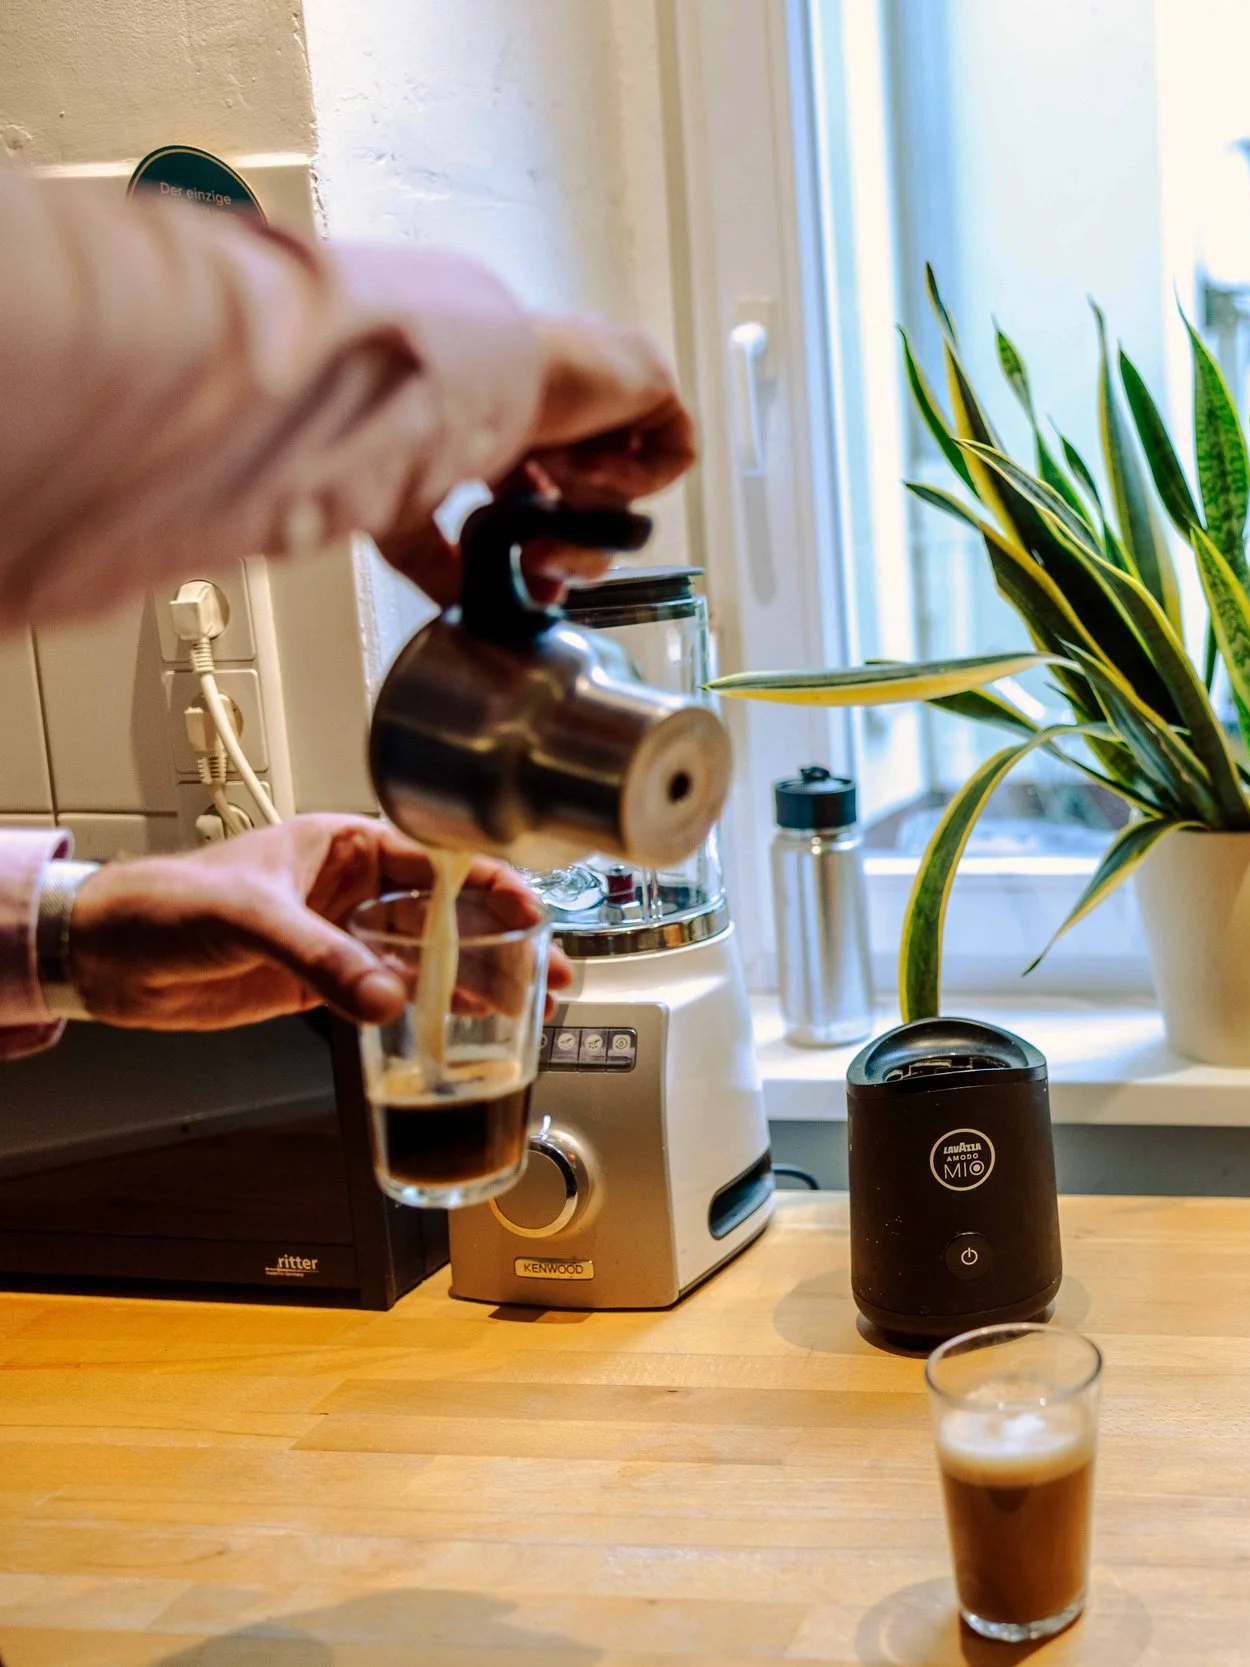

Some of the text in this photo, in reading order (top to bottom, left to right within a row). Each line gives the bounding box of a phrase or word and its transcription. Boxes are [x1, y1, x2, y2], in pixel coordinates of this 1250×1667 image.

[159, 182, 231, 206] Der einzige
[943, 1142, 982, 1154] LAVAZZA
[946, 1153, 979, 1162] AMODO
[944, 1160, 985, 1179] MIO
[278, 1254, 318, 1270] ritter
[524, 1263, 584, 1275] KENWOOD
